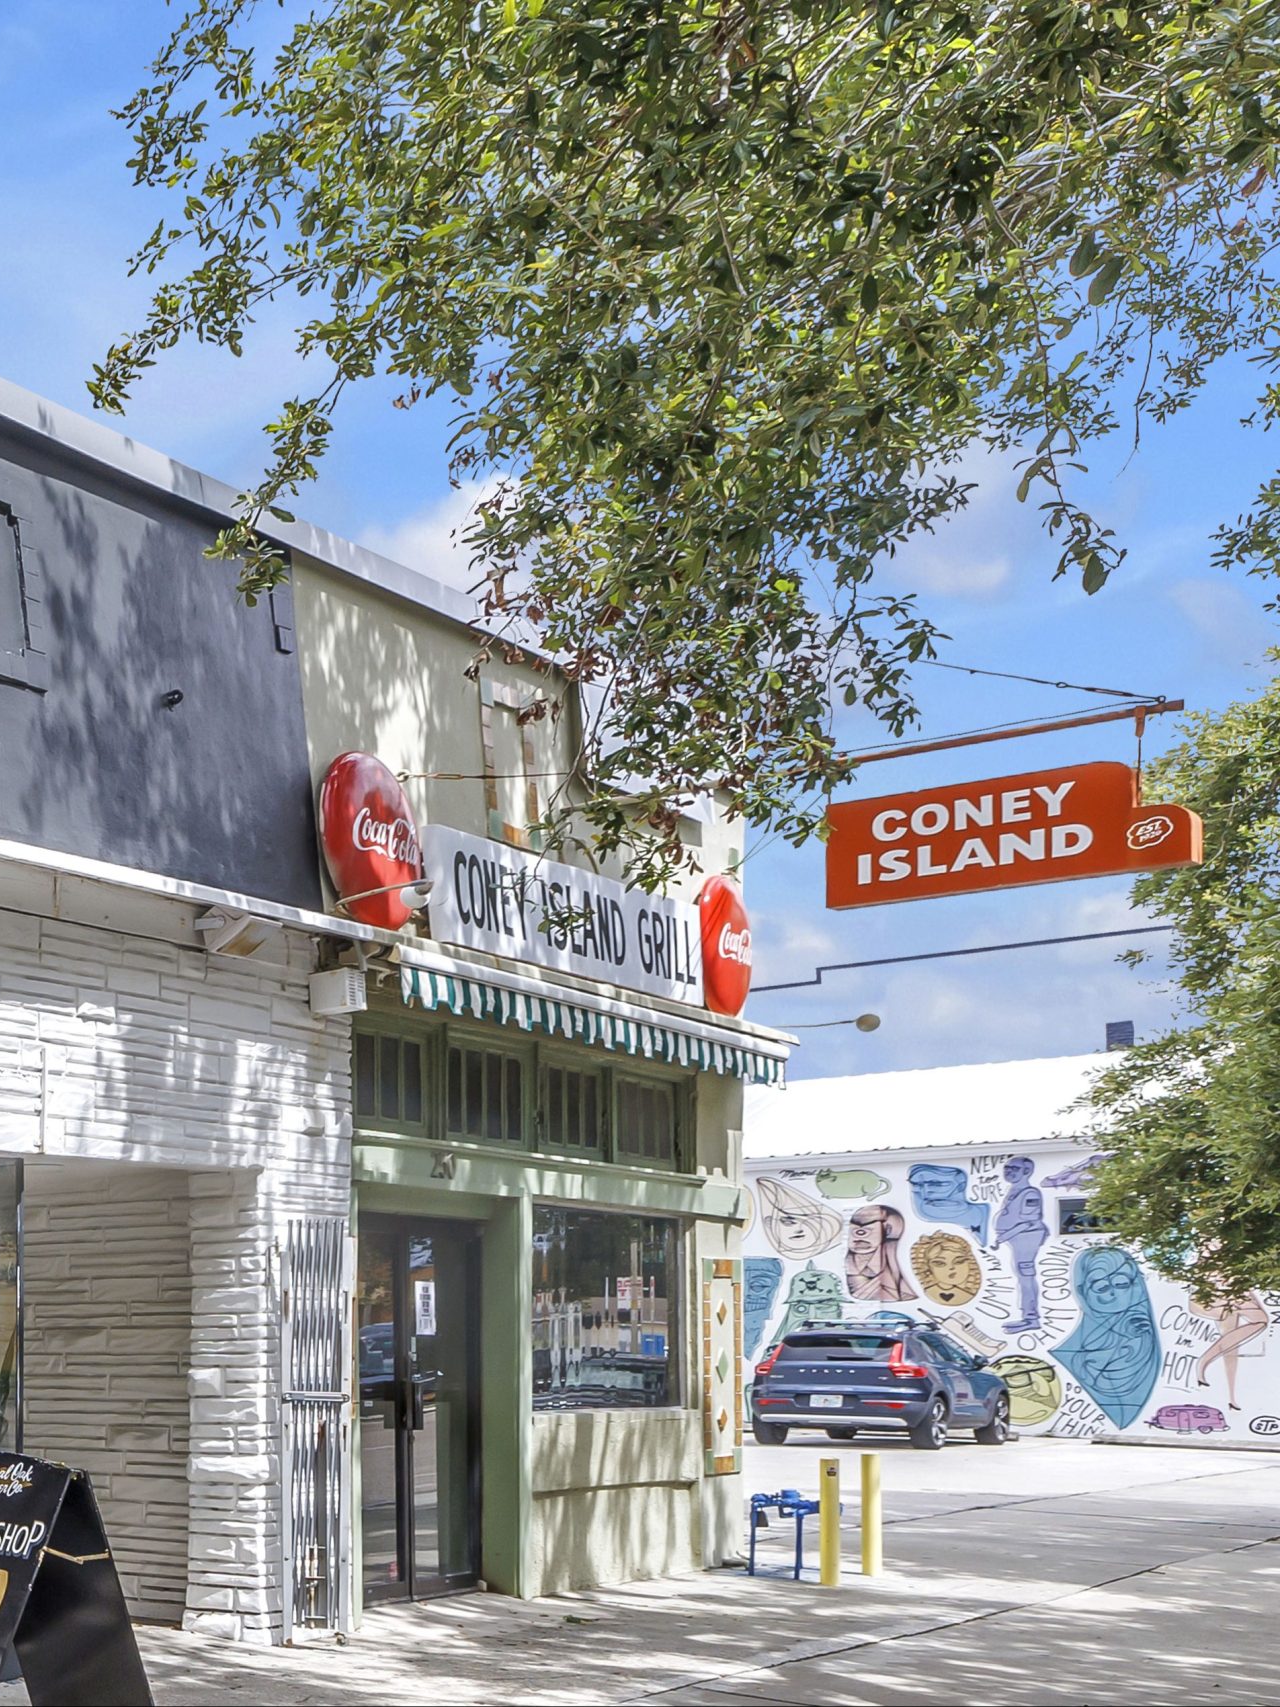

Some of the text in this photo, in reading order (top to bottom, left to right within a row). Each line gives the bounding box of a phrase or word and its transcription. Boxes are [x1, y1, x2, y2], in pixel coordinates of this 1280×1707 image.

[871, 781, 1076, 842] CONEY
[857, 824, 1093, 886] ISLAND
[454, 851, 528, 940] CONEY
[638, 908, 697, 986] GRILL
[970, 1153, 1014, 1175] NEVE
[969, 1181, 1005, 1203] SURE
[975, 1276, 1015, 1320] UMM
[1017, 1330, 1057, 1351] OH
[1041, 1305, 1077, 1333] MY
[1159, 1304, 1221, 1344] COMING
[1161, 1351, 1199, 1387] HOT
[1065, 1382, 1082, 1394] DO
[1050, 1411, 1106, 1436] THIN
[1061, 1394, 1106, 1426] YOUR
[1255, 1419, 1279, 1432] STP
[10, 1462, 33, 1482] Oak
